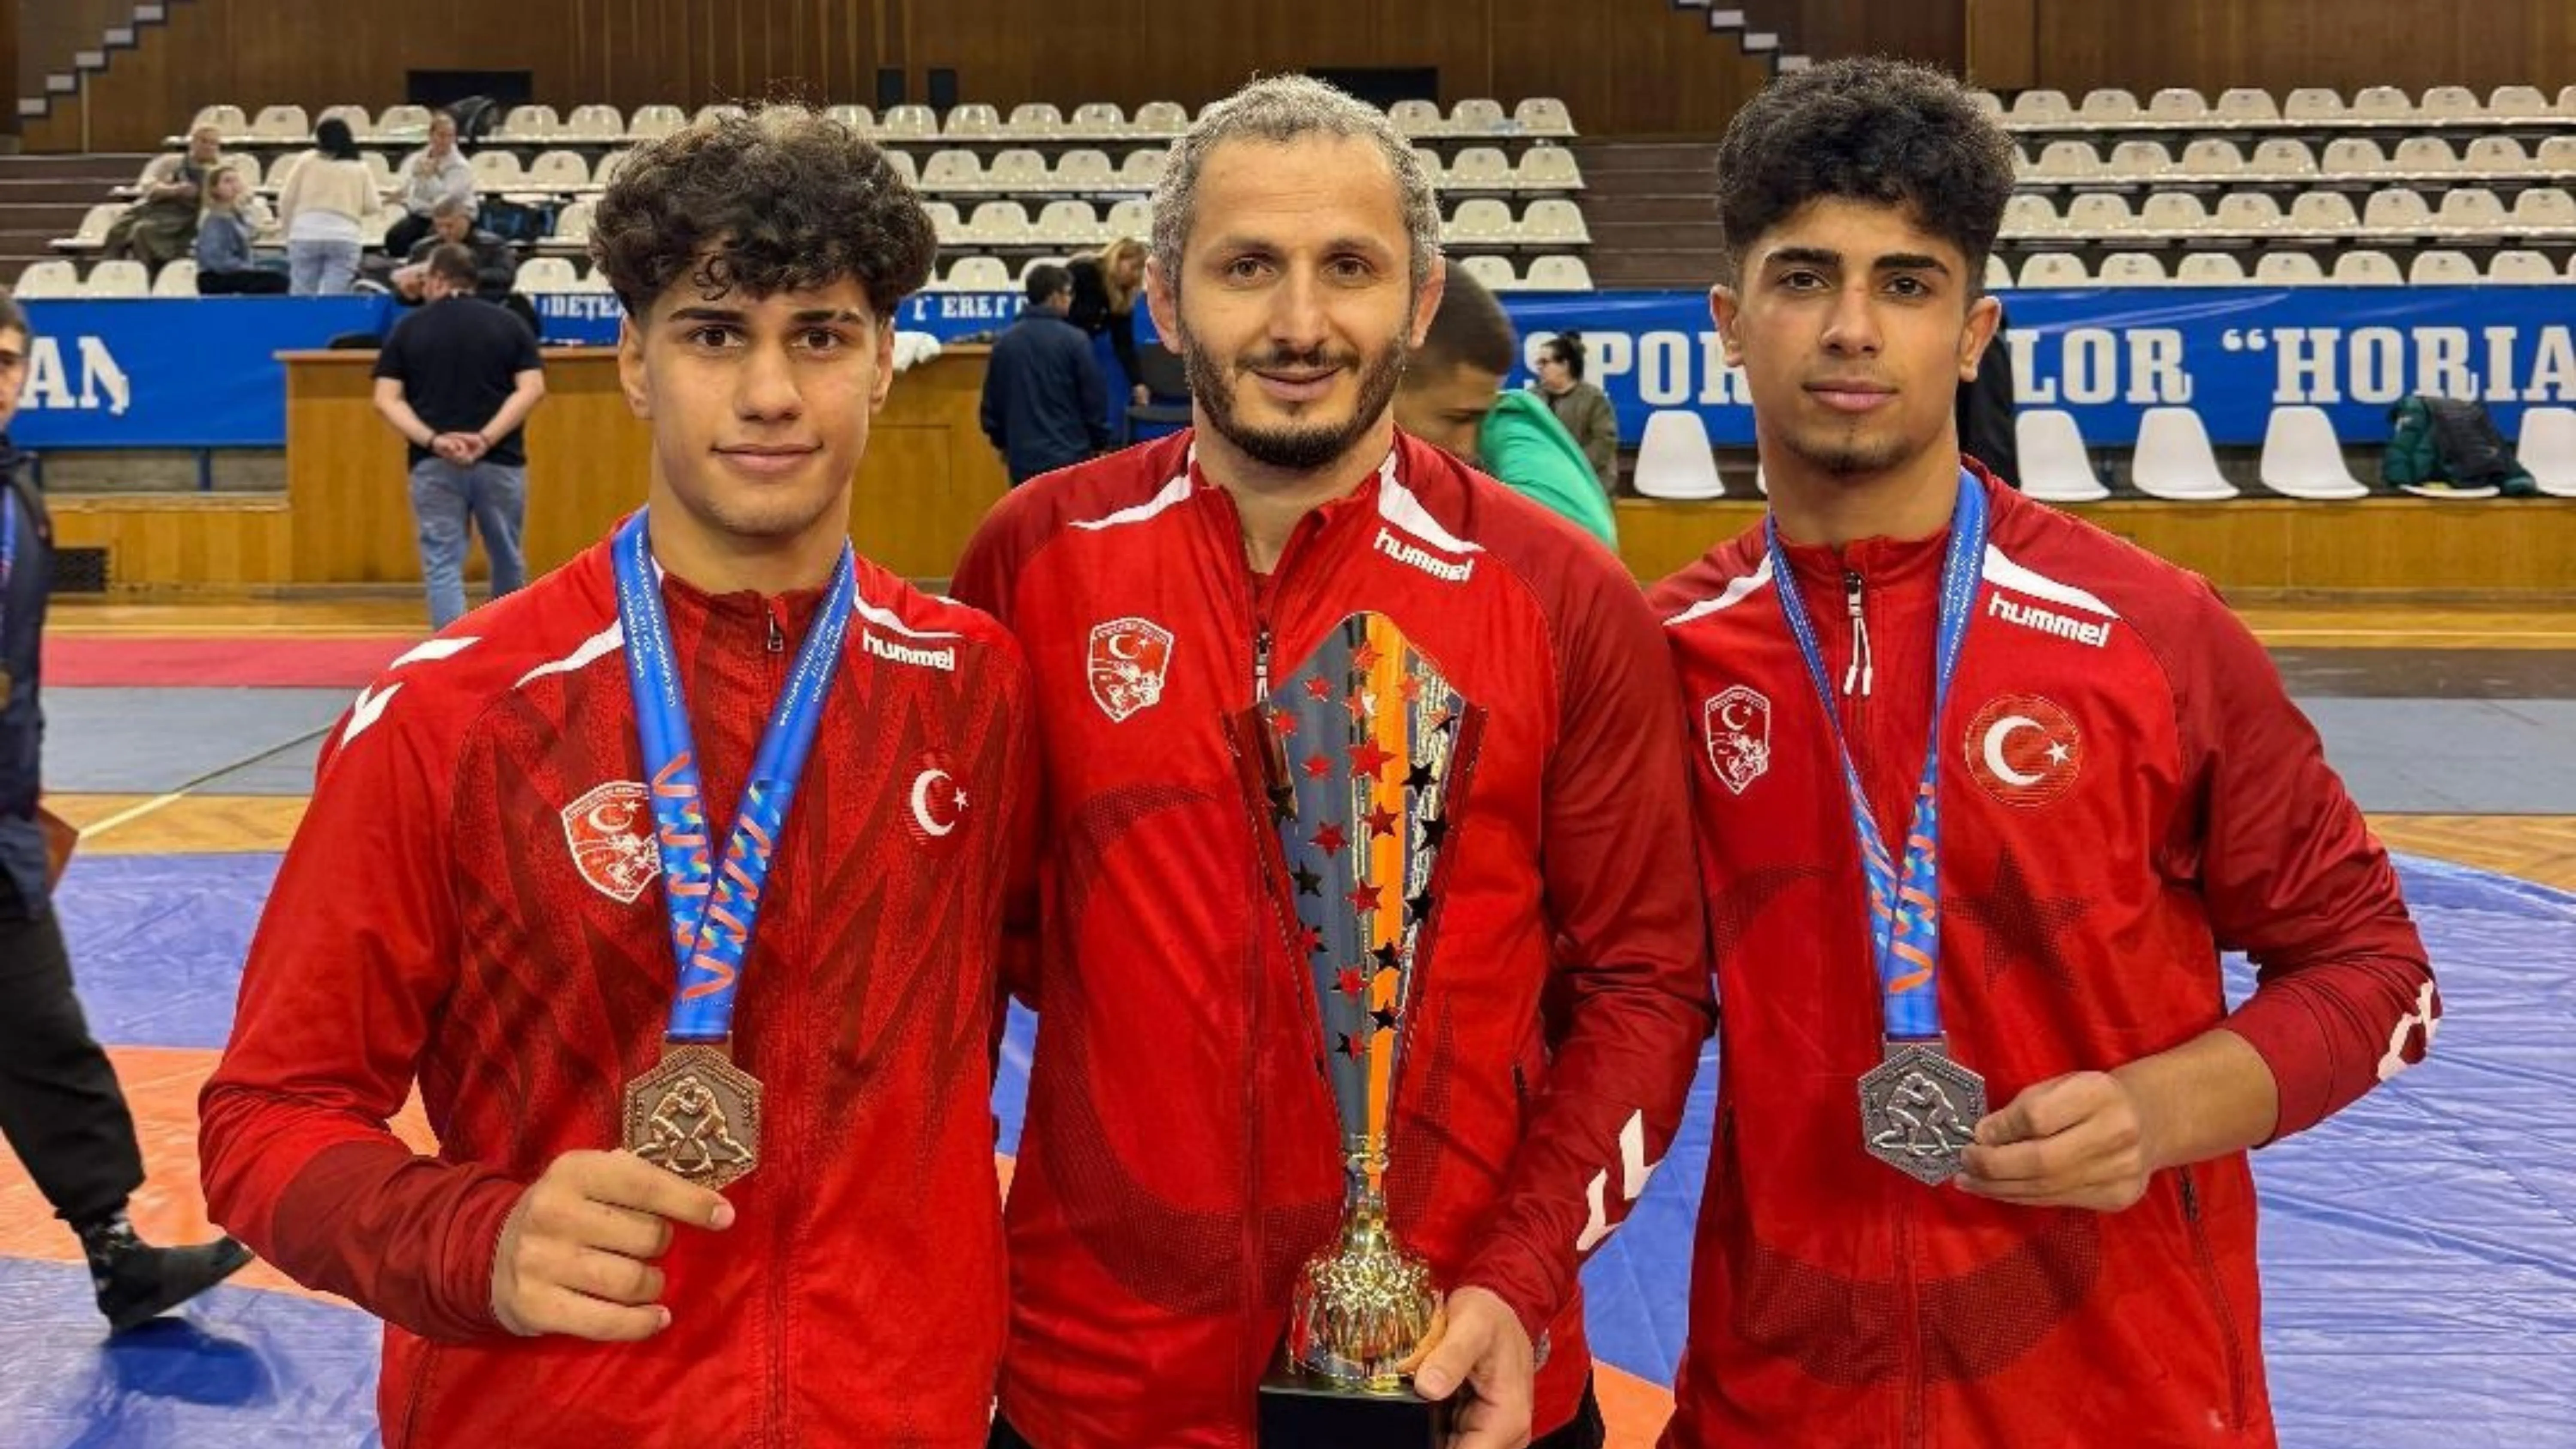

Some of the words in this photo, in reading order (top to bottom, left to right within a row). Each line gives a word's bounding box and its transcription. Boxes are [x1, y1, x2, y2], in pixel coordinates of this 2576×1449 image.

[1374, 527, 1474, 582] hummel
[1988, 591, 2111, 647] hummel
[863, 627, 955, 671] hummel
